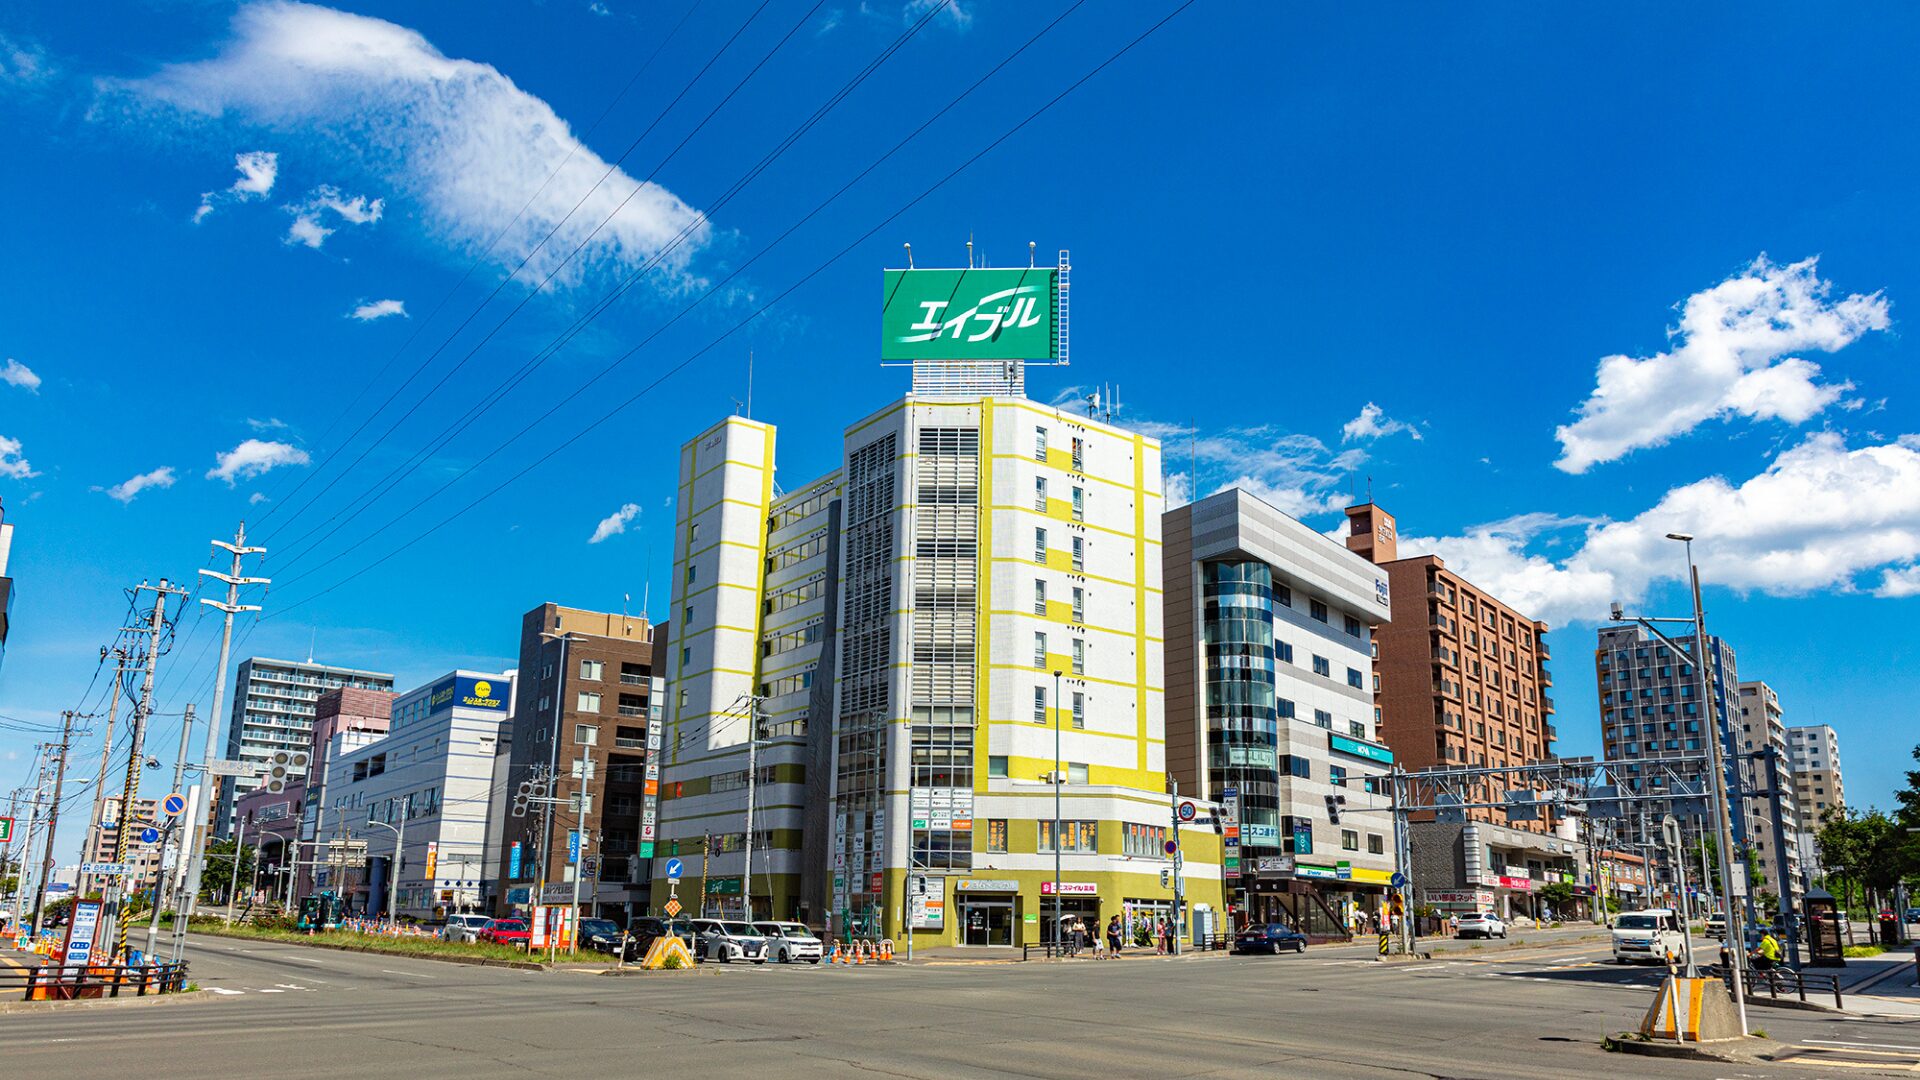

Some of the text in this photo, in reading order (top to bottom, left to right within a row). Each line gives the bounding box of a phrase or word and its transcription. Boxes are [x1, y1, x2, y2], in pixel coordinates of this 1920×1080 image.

[910, 289, 1042, 342] エイブル
[1182, 805, 1193, 816] 50
[1427, 893, 1475, 902] いい部屋ネット
